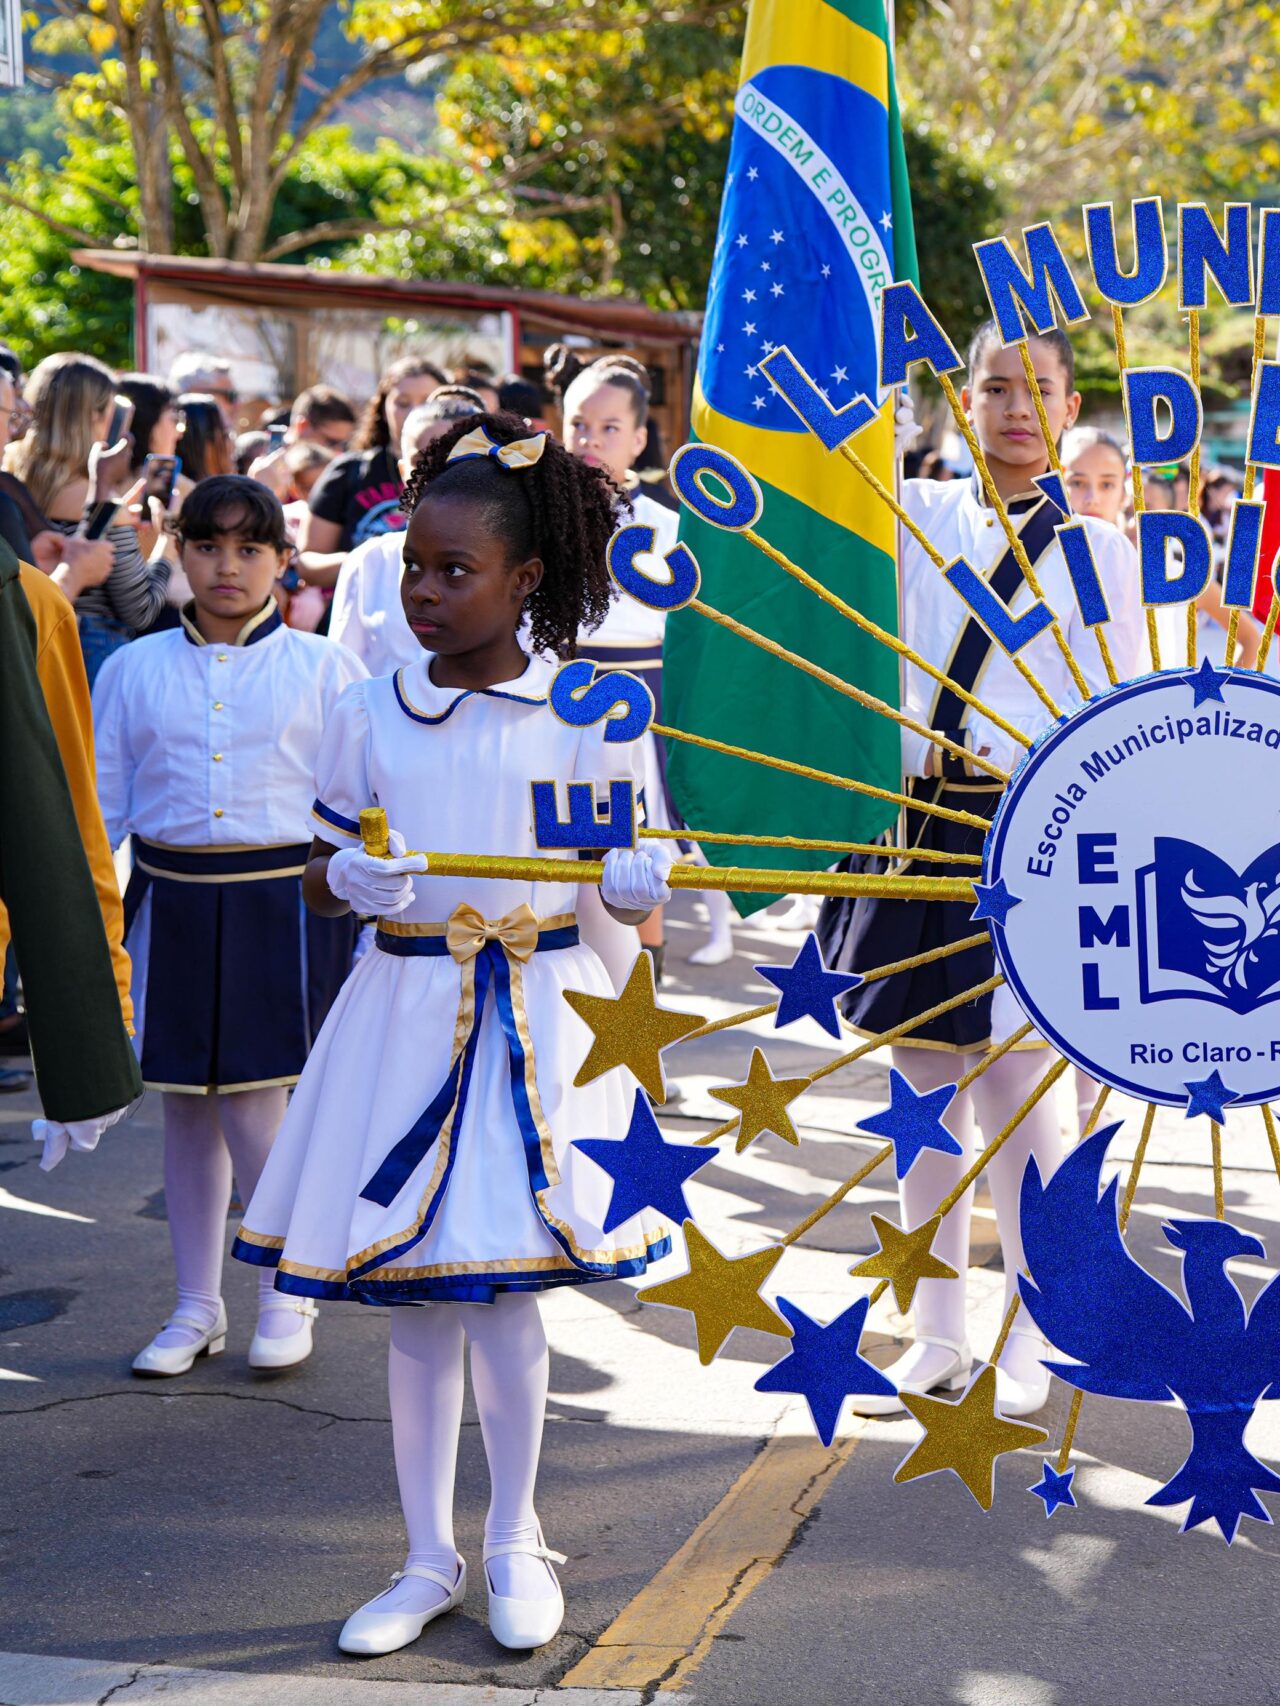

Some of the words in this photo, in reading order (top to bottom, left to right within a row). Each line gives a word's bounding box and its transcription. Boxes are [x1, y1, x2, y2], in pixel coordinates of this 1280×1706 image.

[742, 93, 814, 165] ORDEM
[812, 168, 832, 189] E
[530, 279, 965, 849] ESCOLA
[1027, 785, 1087, 877] Escola
[1130, 1043, 1174, 1064] Rio
[1182, 1042, 1252, 1063] Claro
